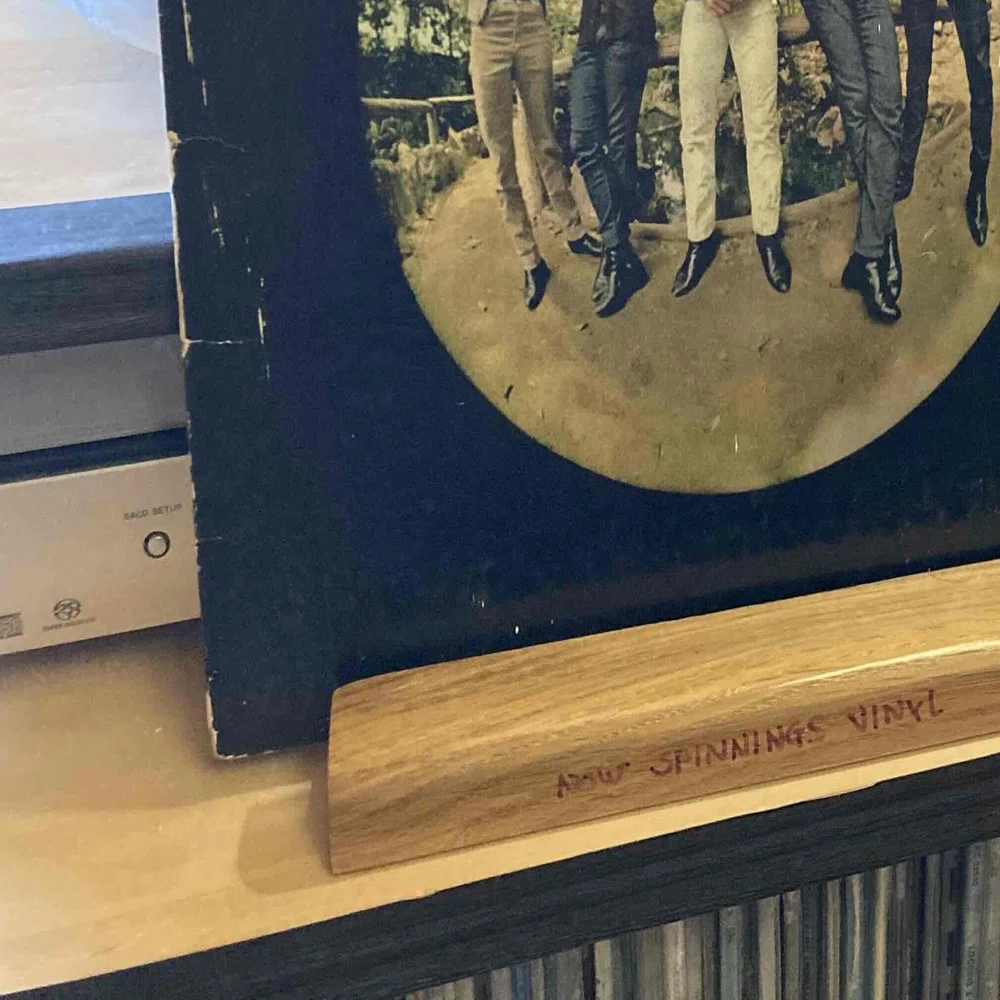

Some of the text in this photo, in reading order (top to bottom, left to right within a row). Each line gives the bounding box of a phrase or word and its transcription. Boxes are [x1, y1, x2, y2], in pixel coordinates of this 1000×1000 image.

[153, 503, 183, 516] SETUP
[649, 714, 828, 778] SPINNINGS
[847, 689, 945, 734] VINYL
